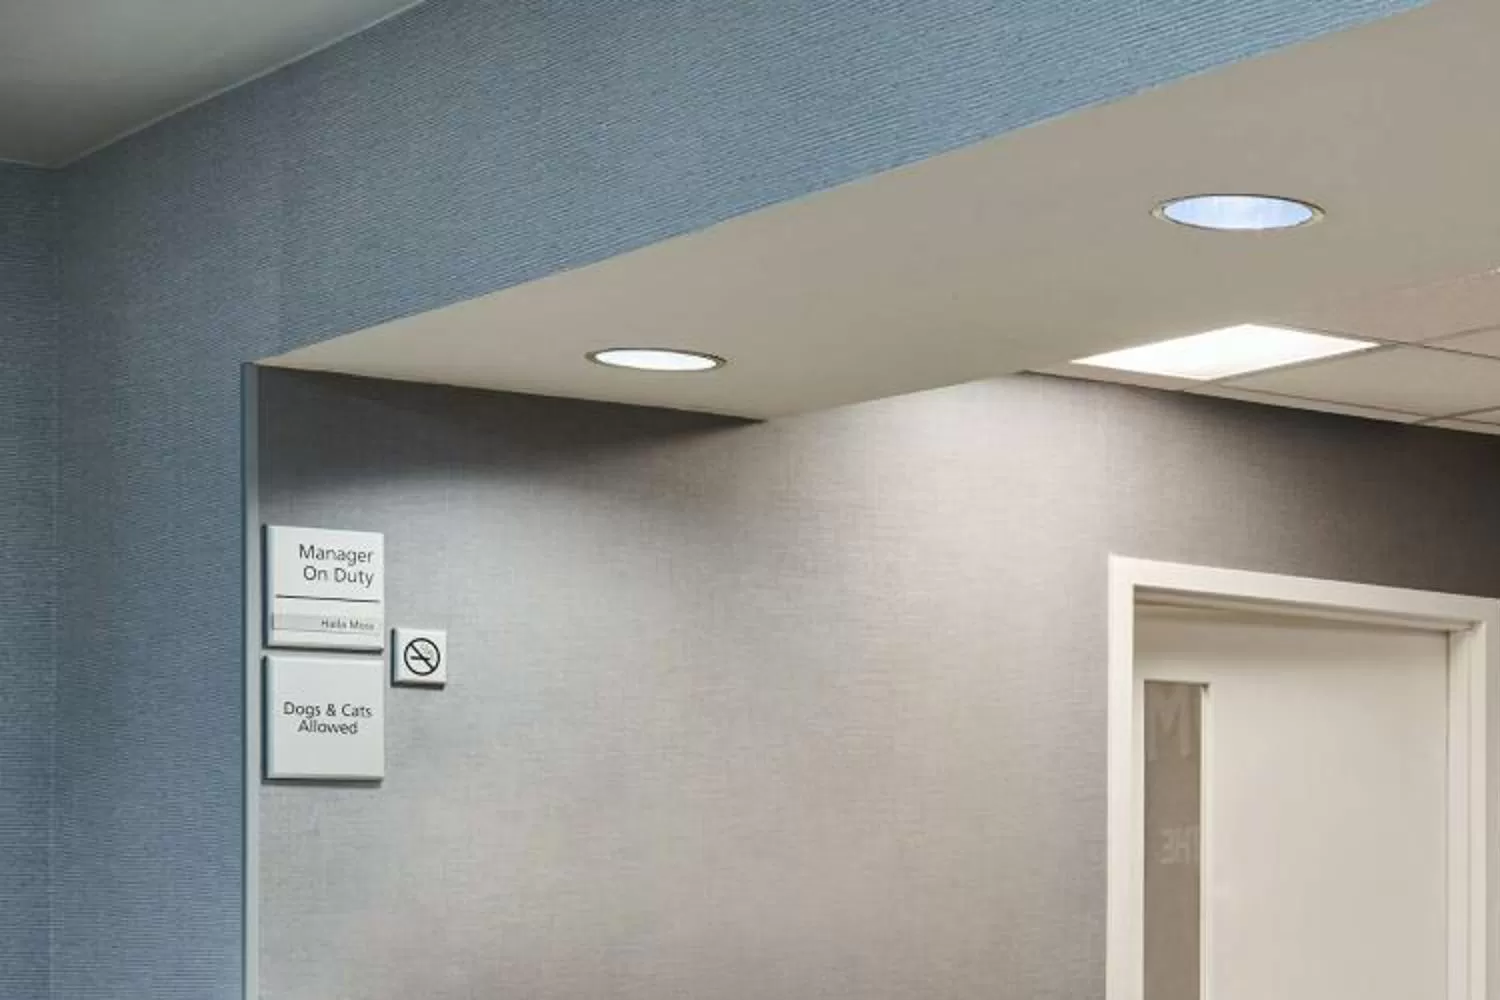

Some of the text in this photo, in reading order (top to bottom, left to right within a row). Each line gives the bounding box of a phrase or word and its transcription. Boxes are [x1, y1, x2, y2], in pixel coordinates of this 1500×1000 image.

[298, 543, 374, 567] Manager
[303, 565, 374, 588] On Duty
[283, 701, 373, 719] Dogs & Cats
[297, 719, 359, 735] Allowed
